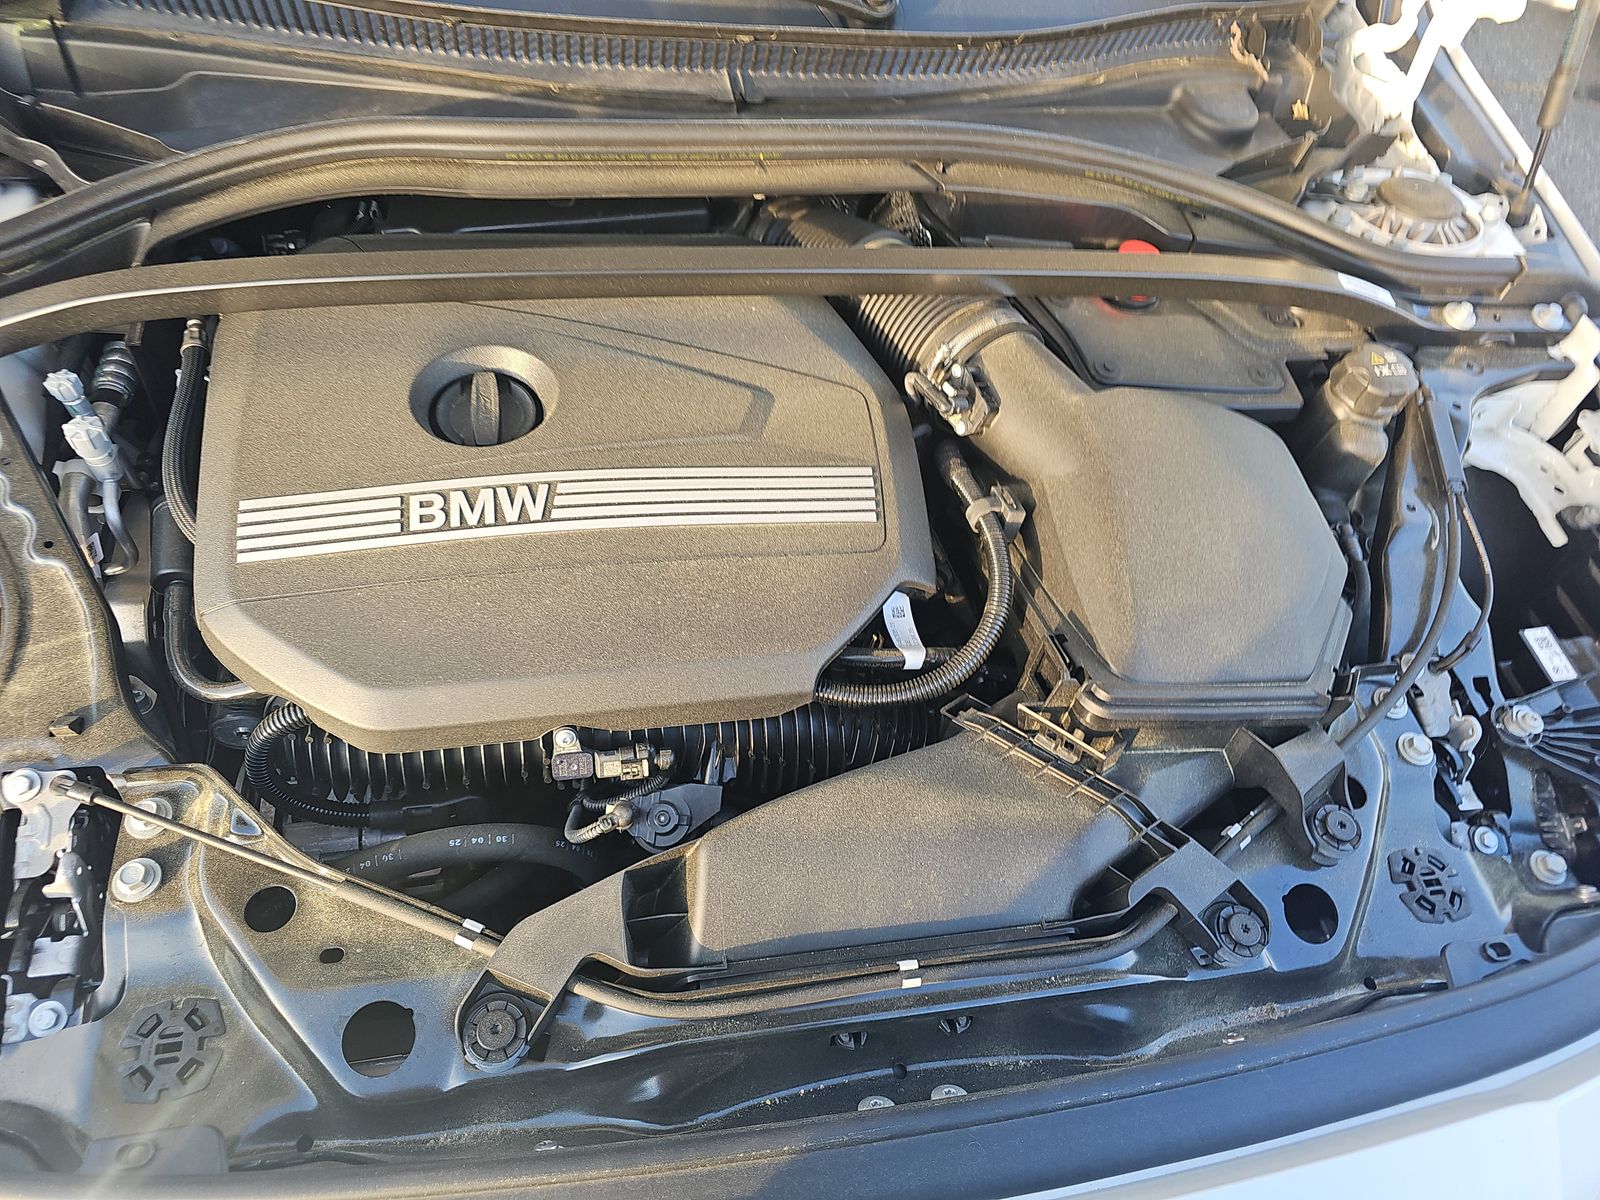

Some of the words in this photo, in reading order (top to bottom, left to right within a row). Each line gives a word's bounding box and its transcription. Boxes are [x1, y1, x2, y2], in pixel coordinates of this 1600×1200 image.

[409, 483, 549, 531] BMW
[449, 839, 462, 847] 25
[471, 836, 484, 844] 04
[495, 835, 508, 843] 30
